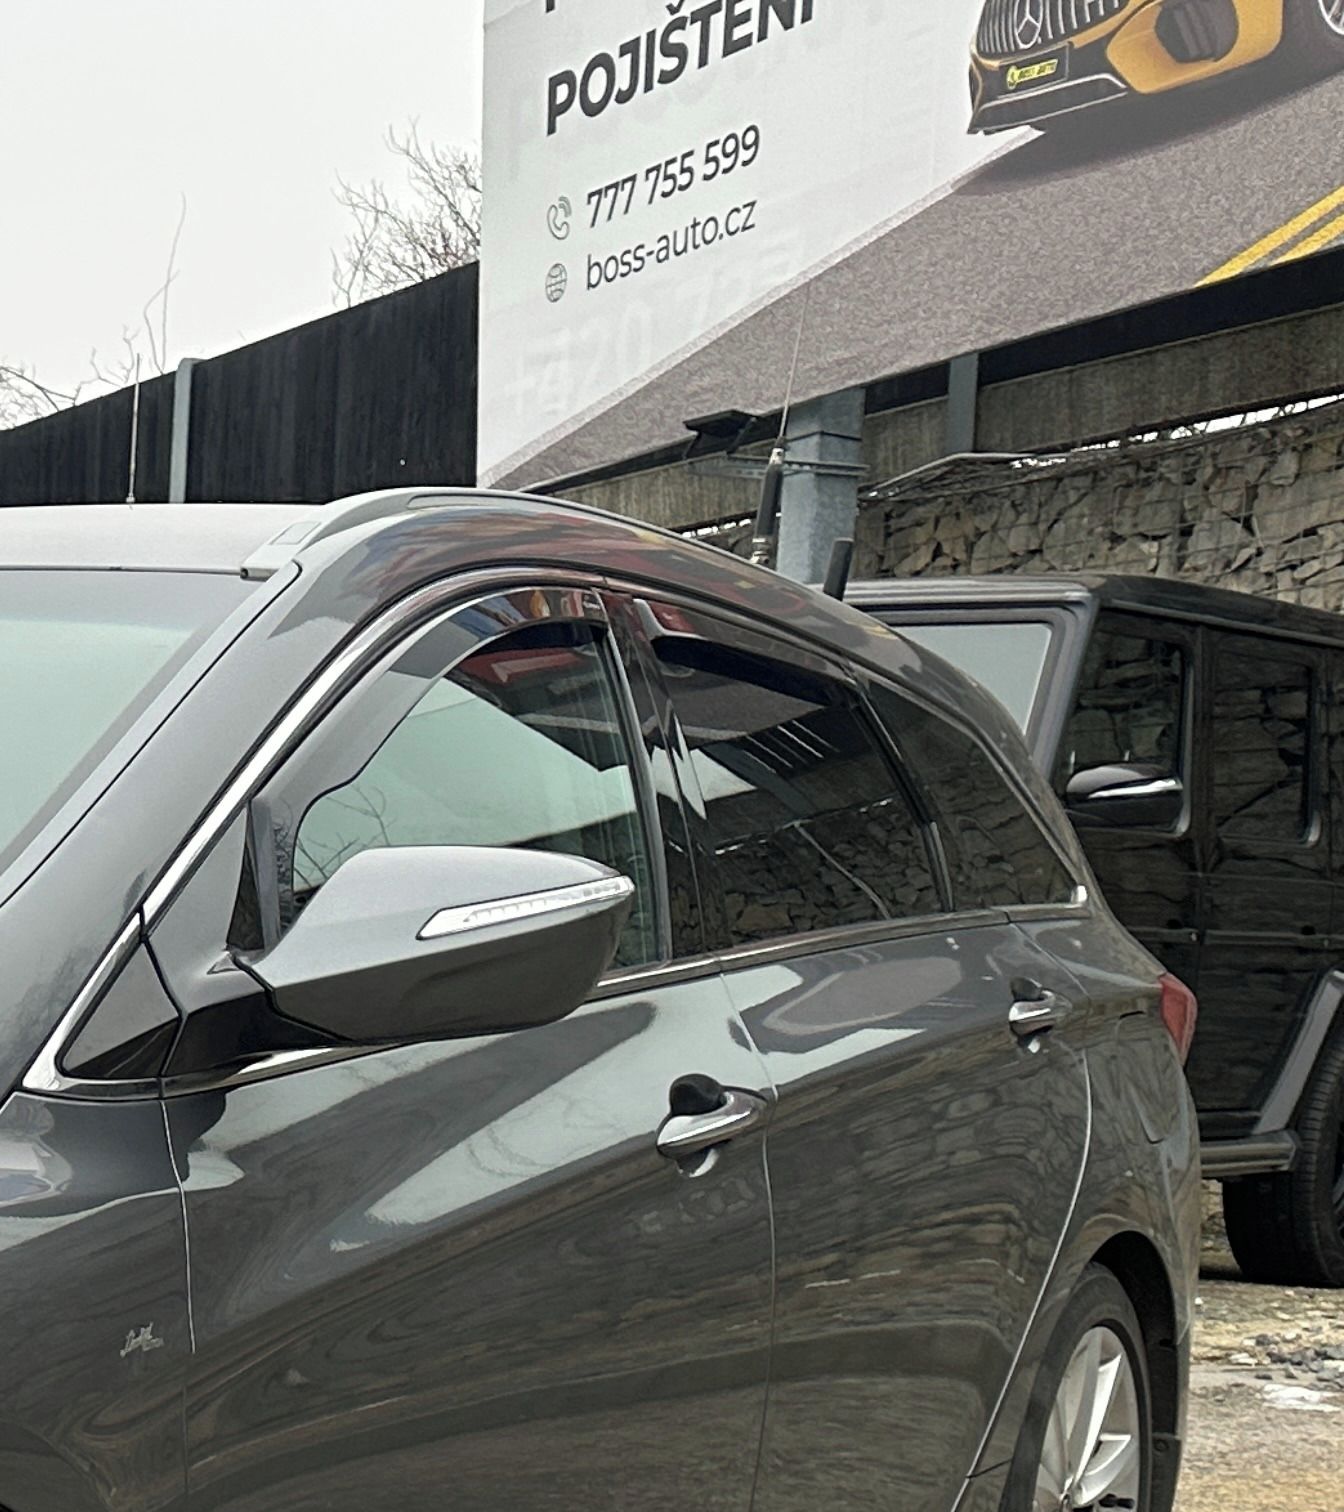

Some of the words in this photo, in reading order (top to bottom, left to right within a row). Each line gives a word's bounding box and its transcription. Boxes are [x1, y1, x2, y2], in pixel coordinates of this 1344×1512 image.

[586, 173, 638, 228] 777
[644, 149, 696, 206] 755
[702, 124, 760, 182] 599
[586, 199, 758, 291] boss-auto.cz
